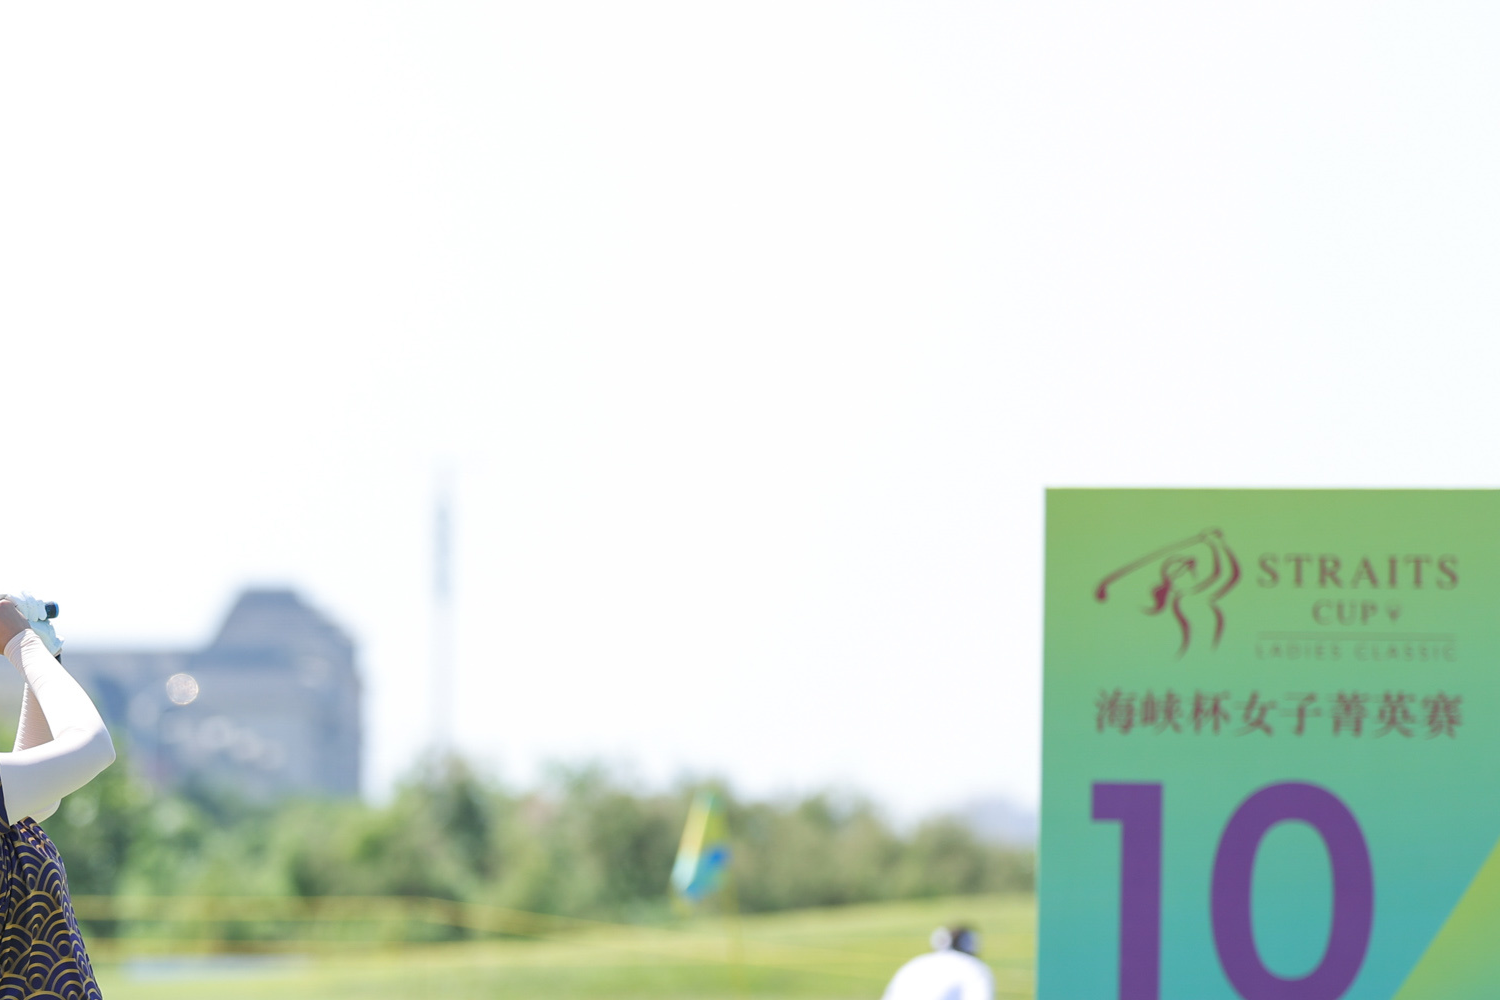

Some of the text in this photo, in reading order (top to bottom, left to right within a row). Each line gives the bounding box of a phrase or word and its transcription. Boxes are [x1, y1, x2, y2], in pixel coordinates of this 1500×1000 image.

[1255, 553, 1460, 591] STRAITS
[1311, 599, 1379, 626] CUP
[1094, 687, 1464, 739] 海峡杯女子菁英赛
